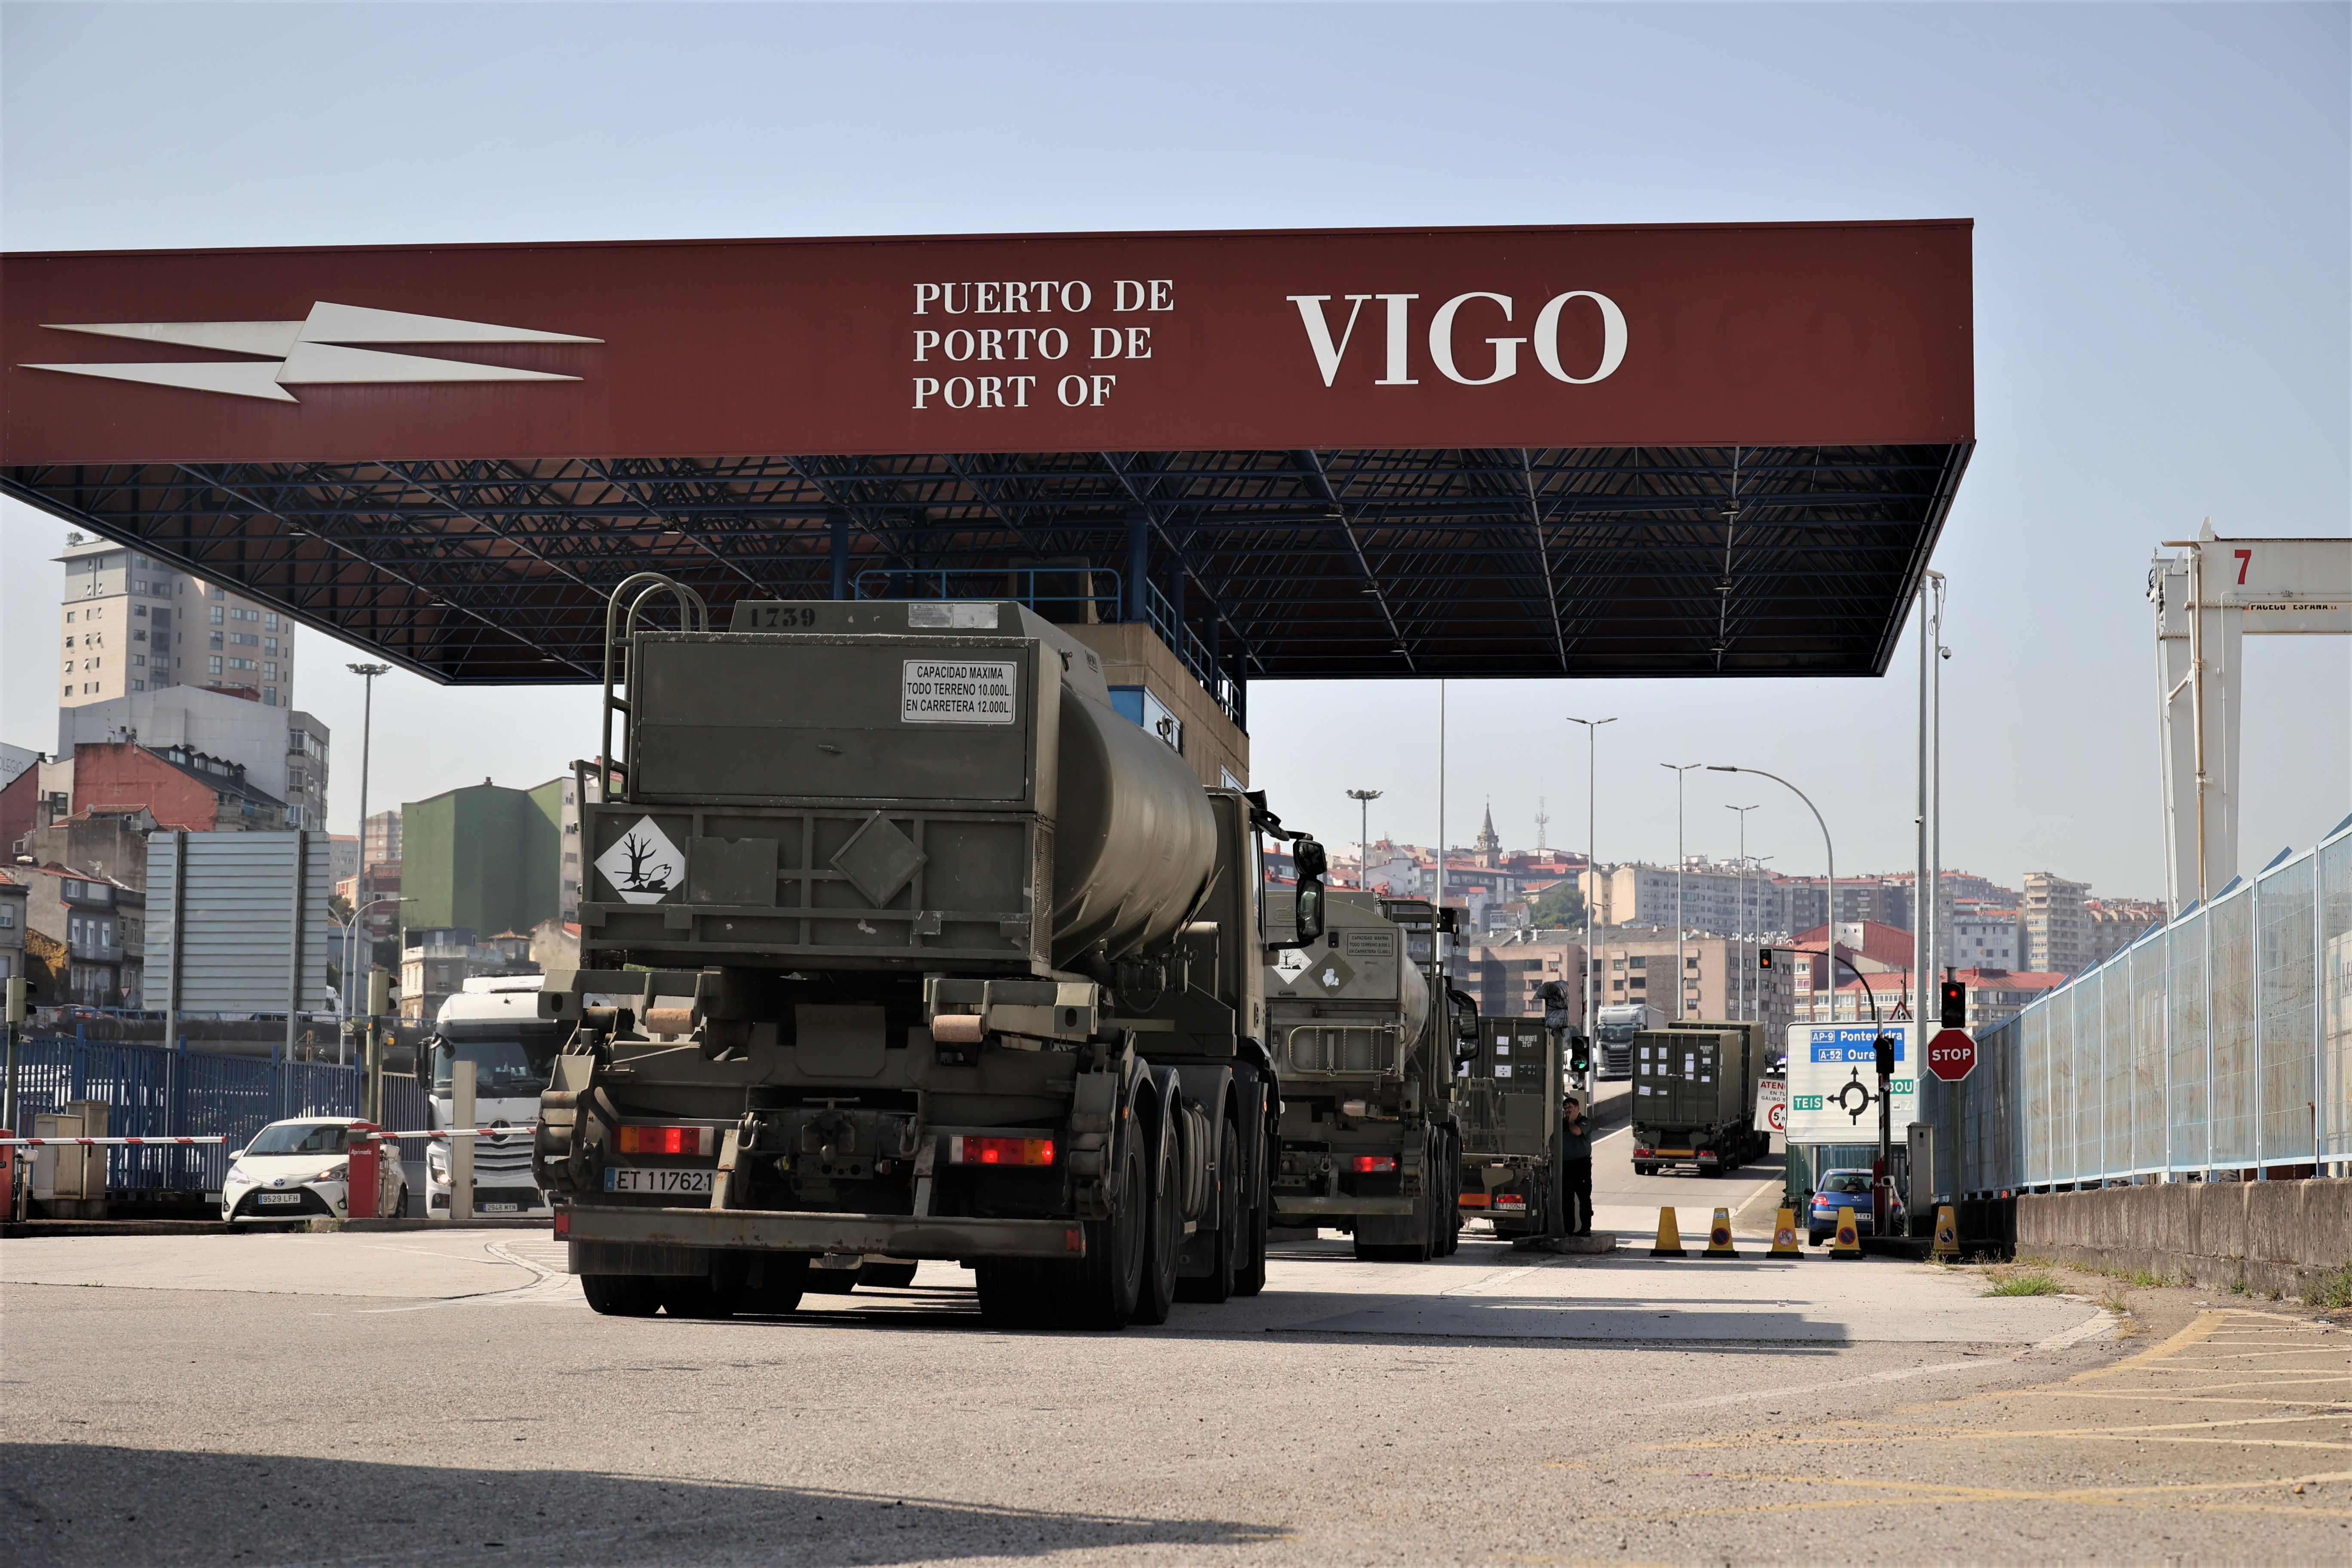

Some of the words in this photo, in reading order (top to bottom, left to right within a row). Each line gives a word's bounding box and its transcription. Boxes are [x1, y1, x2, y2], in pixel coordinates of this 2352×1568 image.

[913, 280, 1092, 314] PUERTO
[1113, 280, 1174, 311] DE
[913, 328, 1069, 361] PORTO
[1090, 327, 1152, 359] DE
[1286, 291, 1628, 387] VIGO
[912, 376, 1036, 409] PORT
[1057, 375, 1116, 406] OF
[2235, 549, 2251, 585] 7
[750, 608, 816, 627] 1739
[917, 666, 967, 678] CAPACIDAD
[969, 667, 1003, 679] MAXIMA
[907, 683, 931, 694] TODO
[934, 683, 975, 695] TERRENO
[978, 684, 1011, 696] 10.000L.
[906, 700, 917, 711] EN
[920, 700, 975, 712] CARRETERA
[978, 701, 1011, 713] 12.000L.
[1812, 1032, 1834, 1041] AP-9
[1820, 1051, 1841, 1059] A-52
[1848, 1049, 1876, 1060] Oure
[1932, 1048, 1971, 1061] STOP
[1760, 1081, 1785, 1089] ATEN
[1890, 1081, 1912, 1092] BOU
[1795, 1098, 1821, 1108] TEIS
[1774, 1112, 1779, 1120] 5
[618, 1171, 641, 1189] ET
[649, 1172, 712, 1191] 117621
